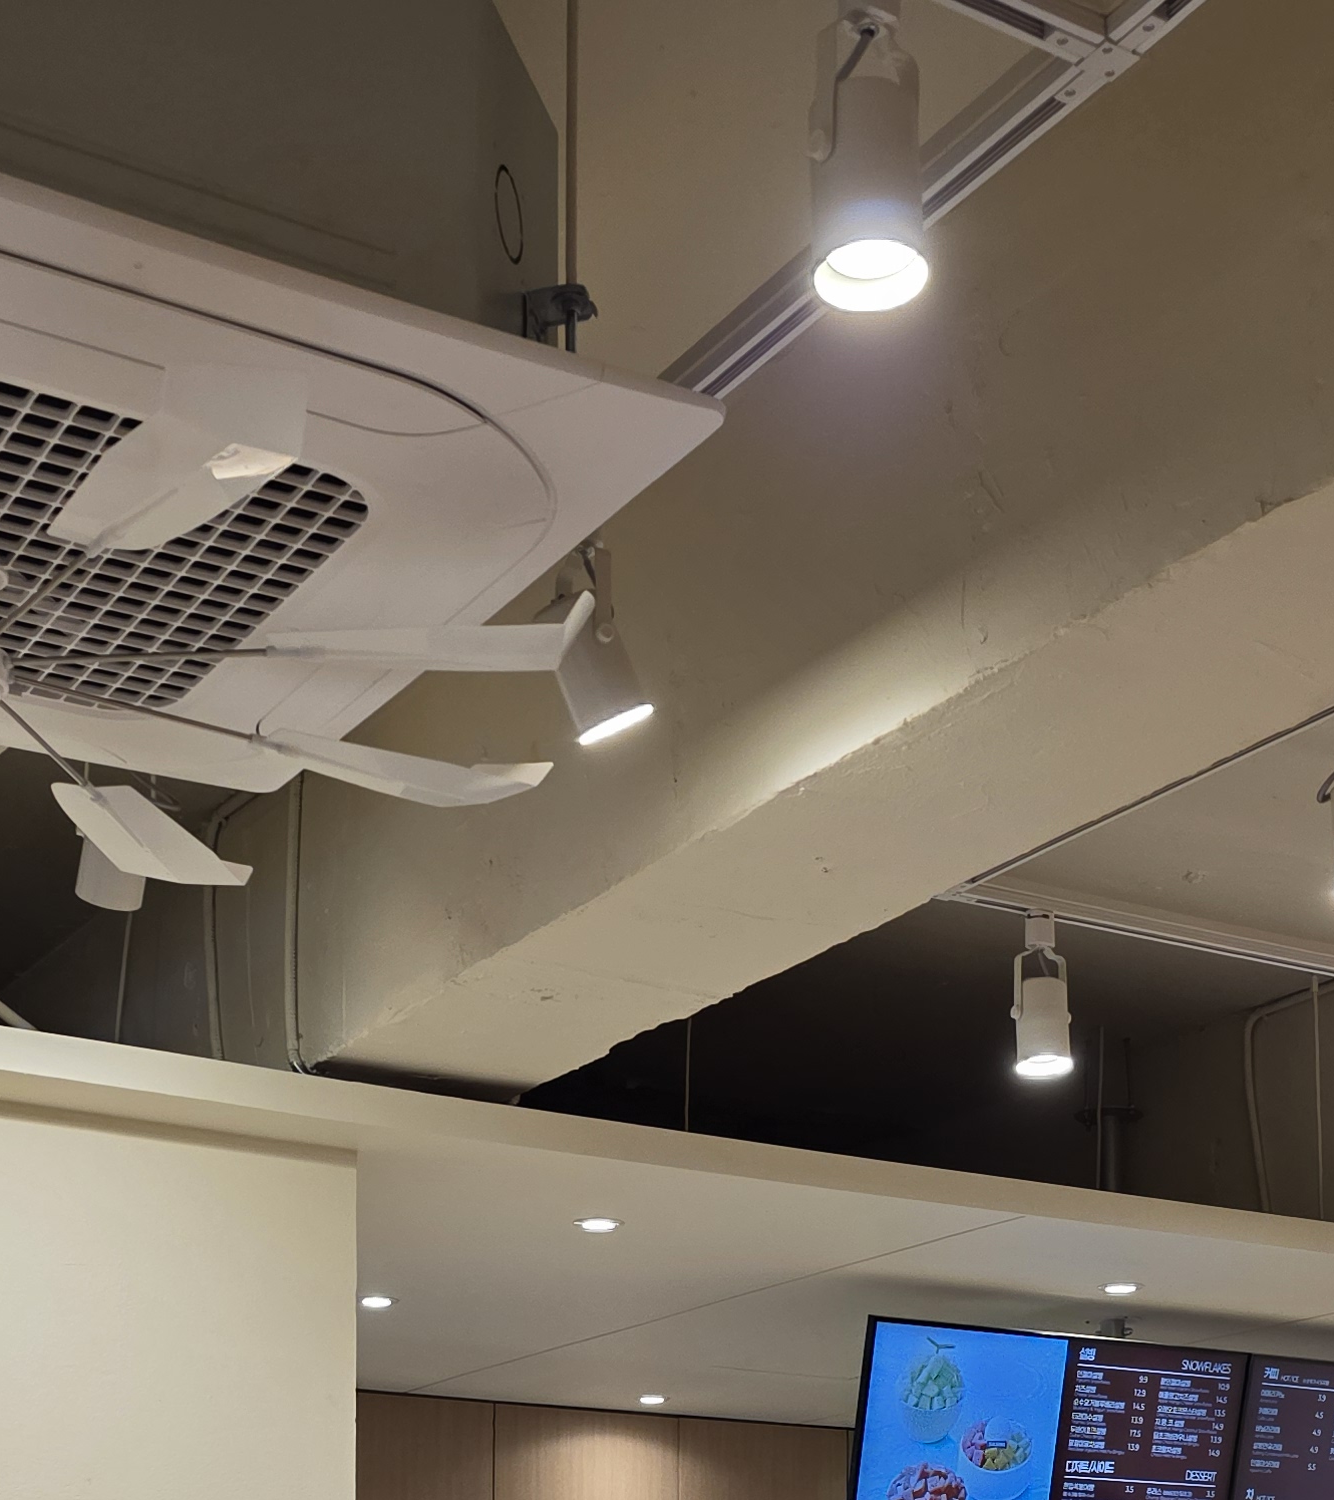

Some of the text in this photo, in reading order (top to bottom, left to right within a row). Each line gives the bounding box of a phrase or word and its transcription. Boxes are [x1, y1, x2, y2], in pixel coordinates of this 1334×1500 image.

[1181, 1359, 1232, 1374] SNOWFLAKES
[1263, 1366, 1280, 1380] 커피
[1065, 1460, 1217, 1482] 디저트/사이드 DESSERT
[1245, 1488, 1255, 1500] 차
